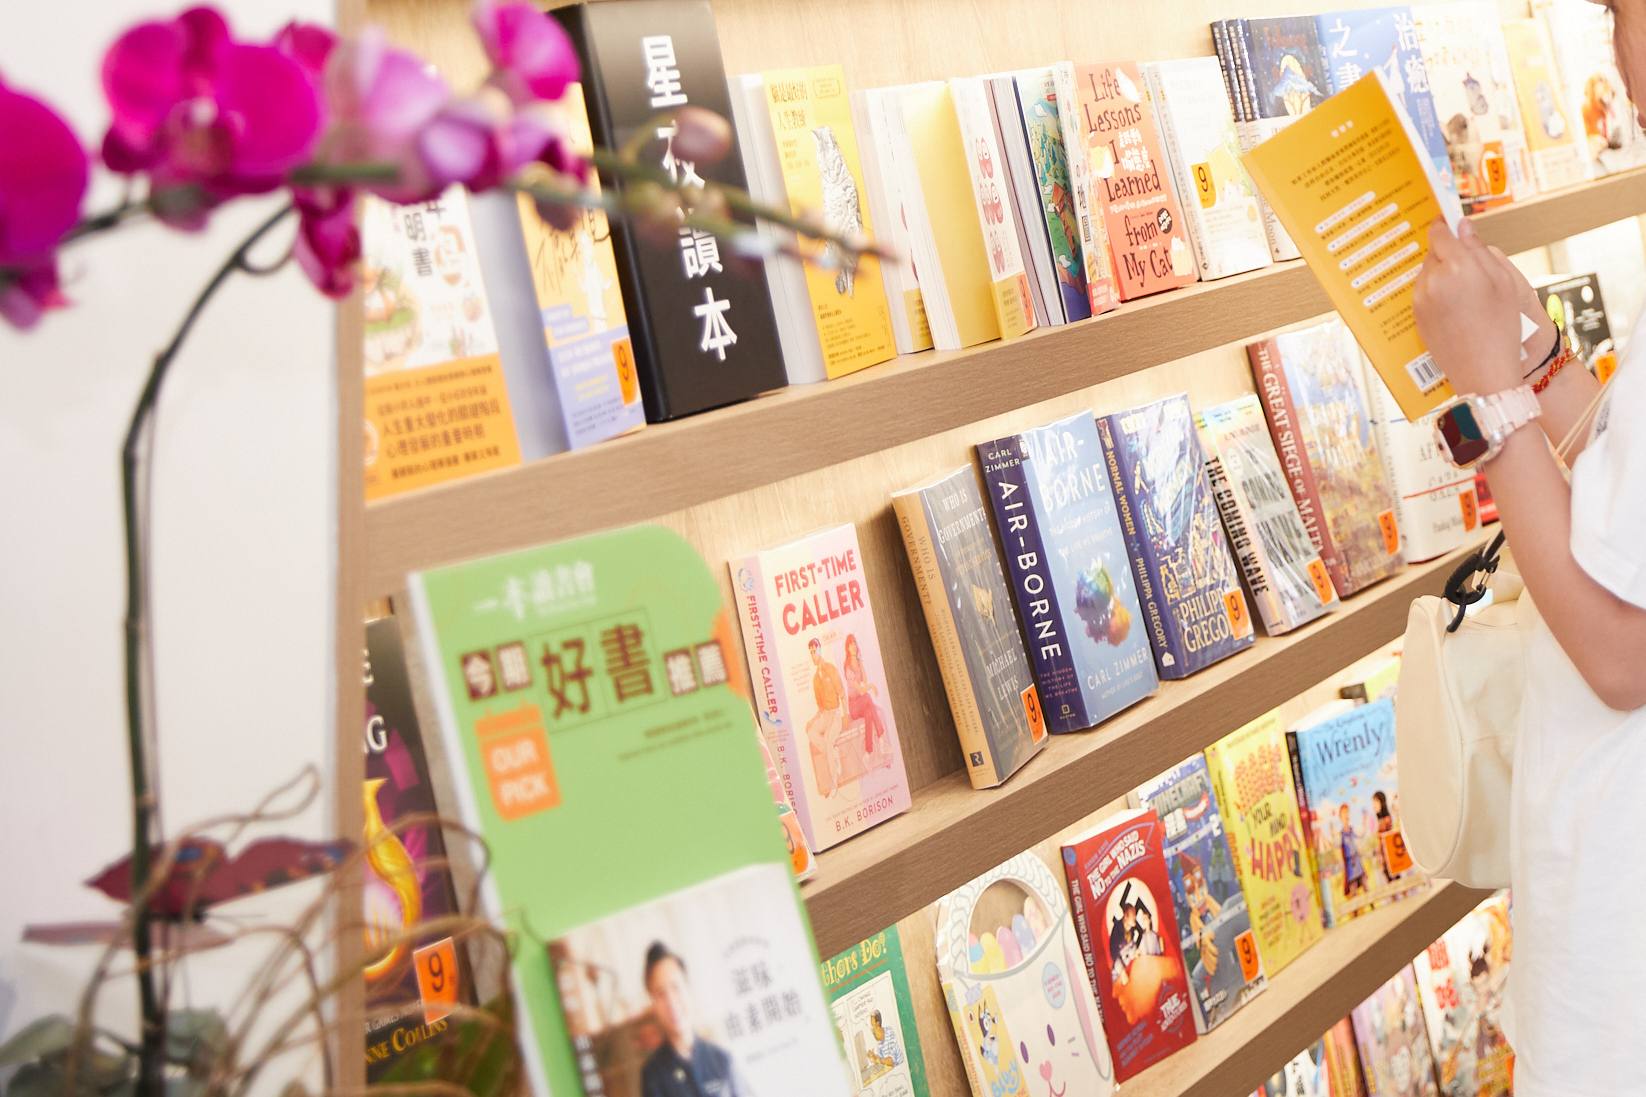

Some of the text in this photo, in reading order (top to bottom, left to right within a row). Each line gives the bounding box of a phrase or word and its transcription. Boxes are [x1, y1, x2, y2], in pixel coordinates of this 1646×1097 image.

[1088, 68, 1121, 102] Life
[1083, 102, 1142, 134] Lessons
[1109, 139, 1120, 165] I
[1103, 159, 1162, 203] Learned
[1198, 166, 1209, 193] 9
[1124, 215, 1158, 247] from
[1264, 210, 1277, 246] Moon
[1122, 246, 1174, 288] My Cat
[616, 344, 630, 382] 9
[984, 458, 1021, 473] ZIMMER
[988, 448, 1013, 461] CARL
[1258, 349, 1325, 555] THE GREAT SIEGE OF MALTA
[942, 488, 969, 513] WHO IS
[1040, 463, 1106, 514] BORNE
[938, 507, 988, 545] GOVERNMENT?
[1081, 509, 1103, 527] HISTORY
[1093, 527, 1114, 544] BREATHE
[1205, 455, 1269, 597] THE COMING WAVE
[901, 515, 932, 606] GOVERNMENT?
[918, 535, 931, 566] WHO
[1106, 450, 1168, 649] NORMAL WOMEN PHILIPPA GREGORY
[774, 549, 858, 598] FIRST-TIME
[997, 480, 1063, 661] AIR-BORNE
[782, 578, 865, 637] CALLER
[1179, 589, 1227, 624] PHILIPP
[1229, 595, 1241, 621] 9
[746, 594, 769, 663] FIRST-TIME
[761, 666, 779, 715] CALLER
[986, 648, 1018, 680] MICHAEL
[1087, 647, 1149, 691] CARL ZIMMER
[997, 678, 1020, 701] LEWIS
[1026, 692, 1037, 723] 9
[491, 741, 539, 775] OUR
[1316, 718, 1385, 766] Wrenly
[499, 771, 550, 810] PICK
[835, 795, 894, 832] B.K. BORISON
[1087, 830, 1140, 887] THE GIRL WHO SAID
[1394, 834, 1406, 858] 9
[1090, 882, 1107, 901] NO
[1116, 839, 1147, 869] NAZIS
[859, 932, 888, 967] Do?
[1243, 938, 1253, 965] 9
[428, 951, 445, 993] 9
[1160, 992, 1181, 1019] TRUE
